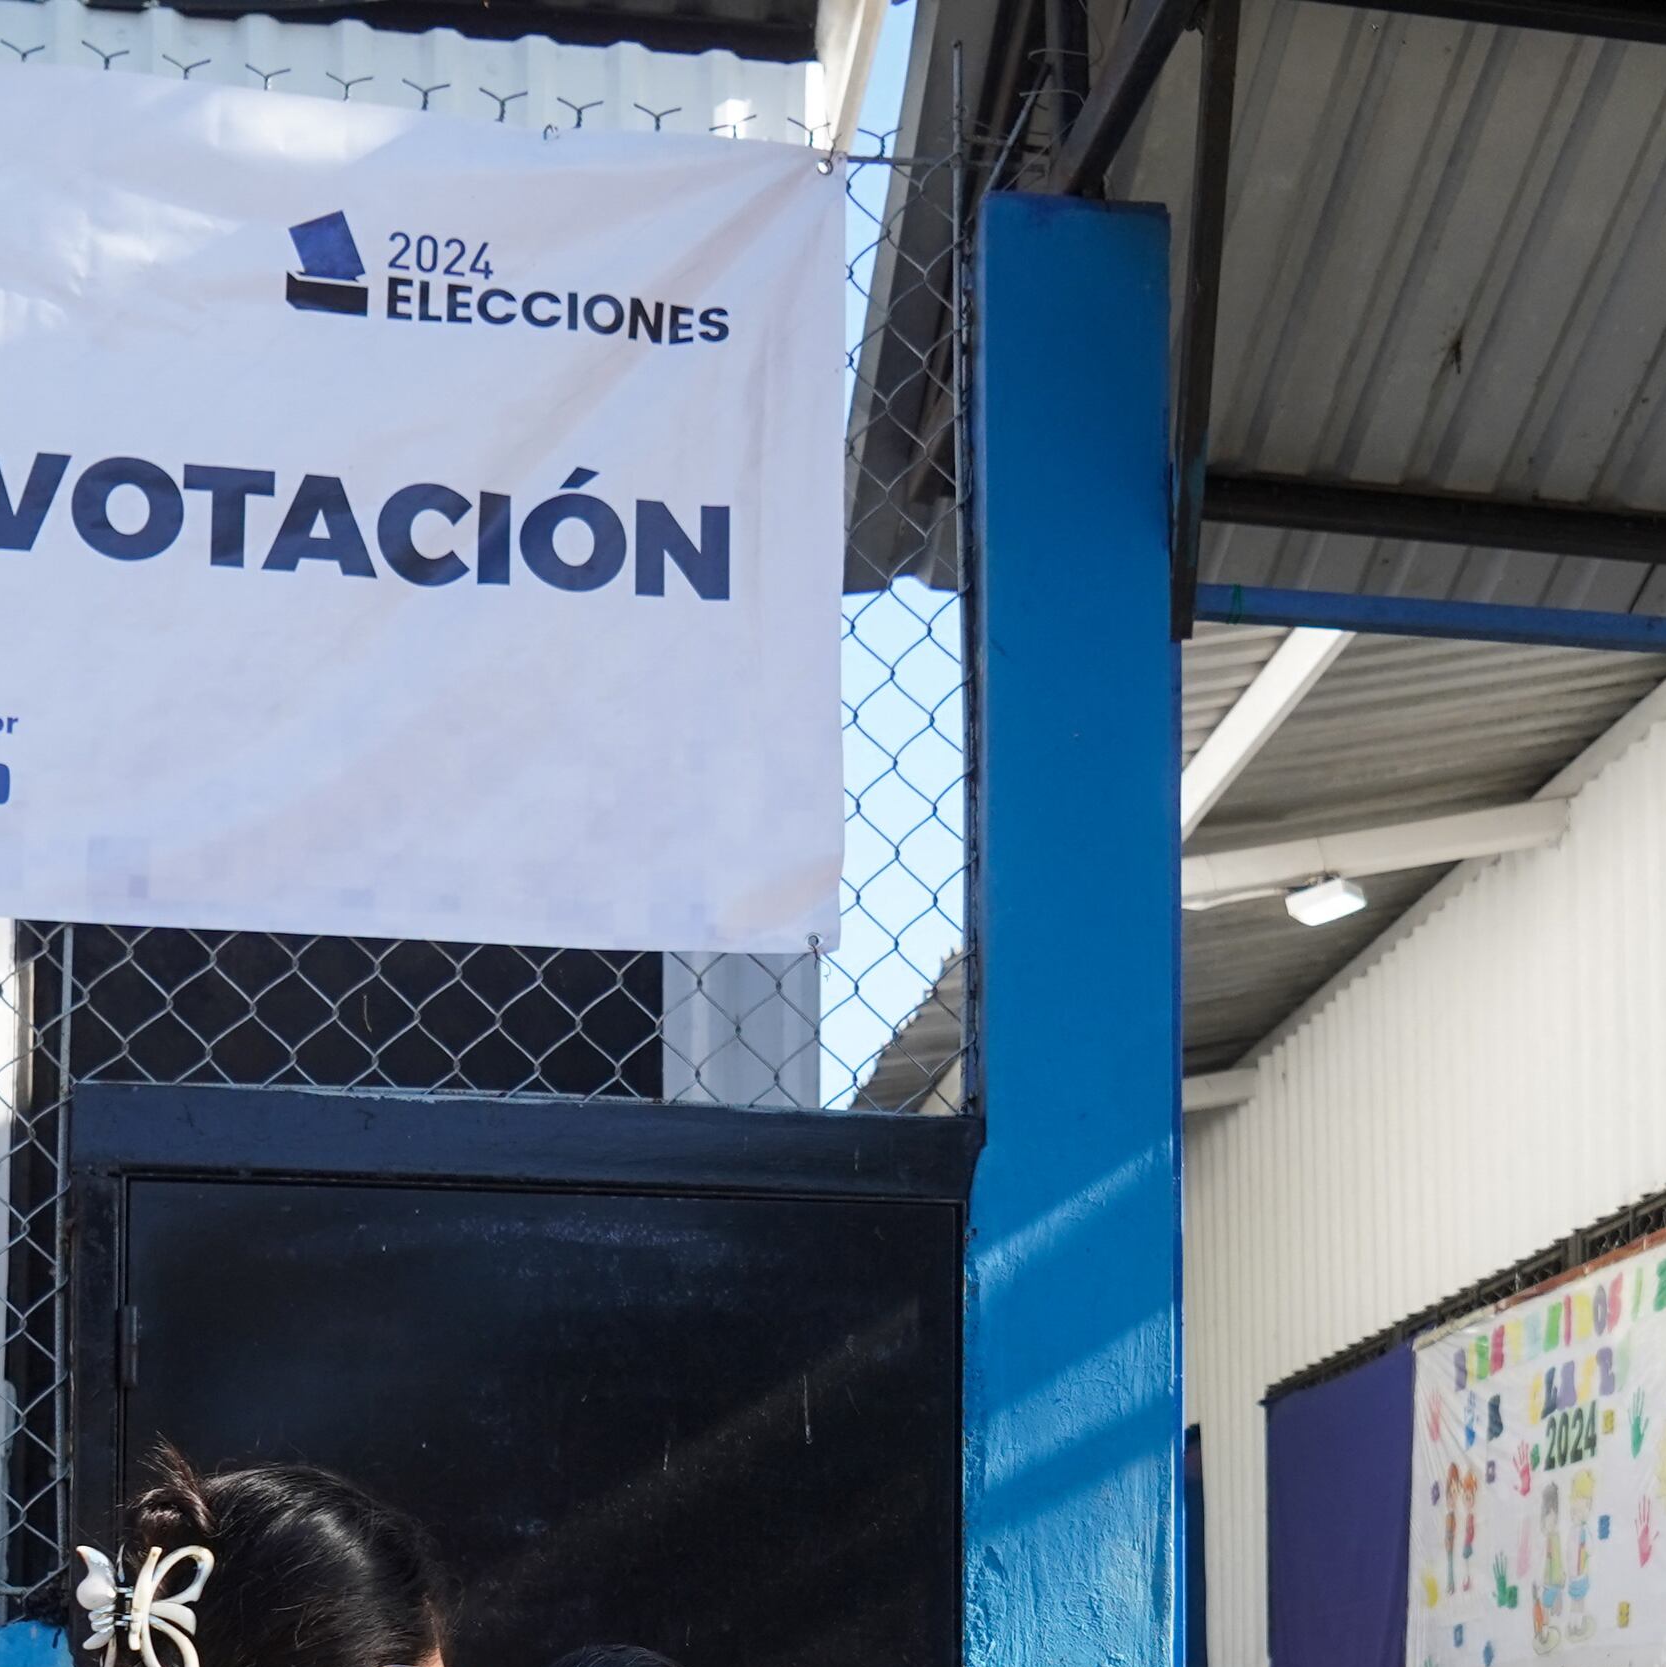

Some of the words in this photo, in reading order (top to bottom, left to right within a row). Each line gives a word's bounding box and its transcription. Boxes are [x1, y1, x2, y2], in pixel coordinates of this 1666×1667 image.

[387, 231, 494, 280] 2024
[386, 275, 730, 344] ELECCIONES
[1543, 1400, 1597, 1471] 2024
